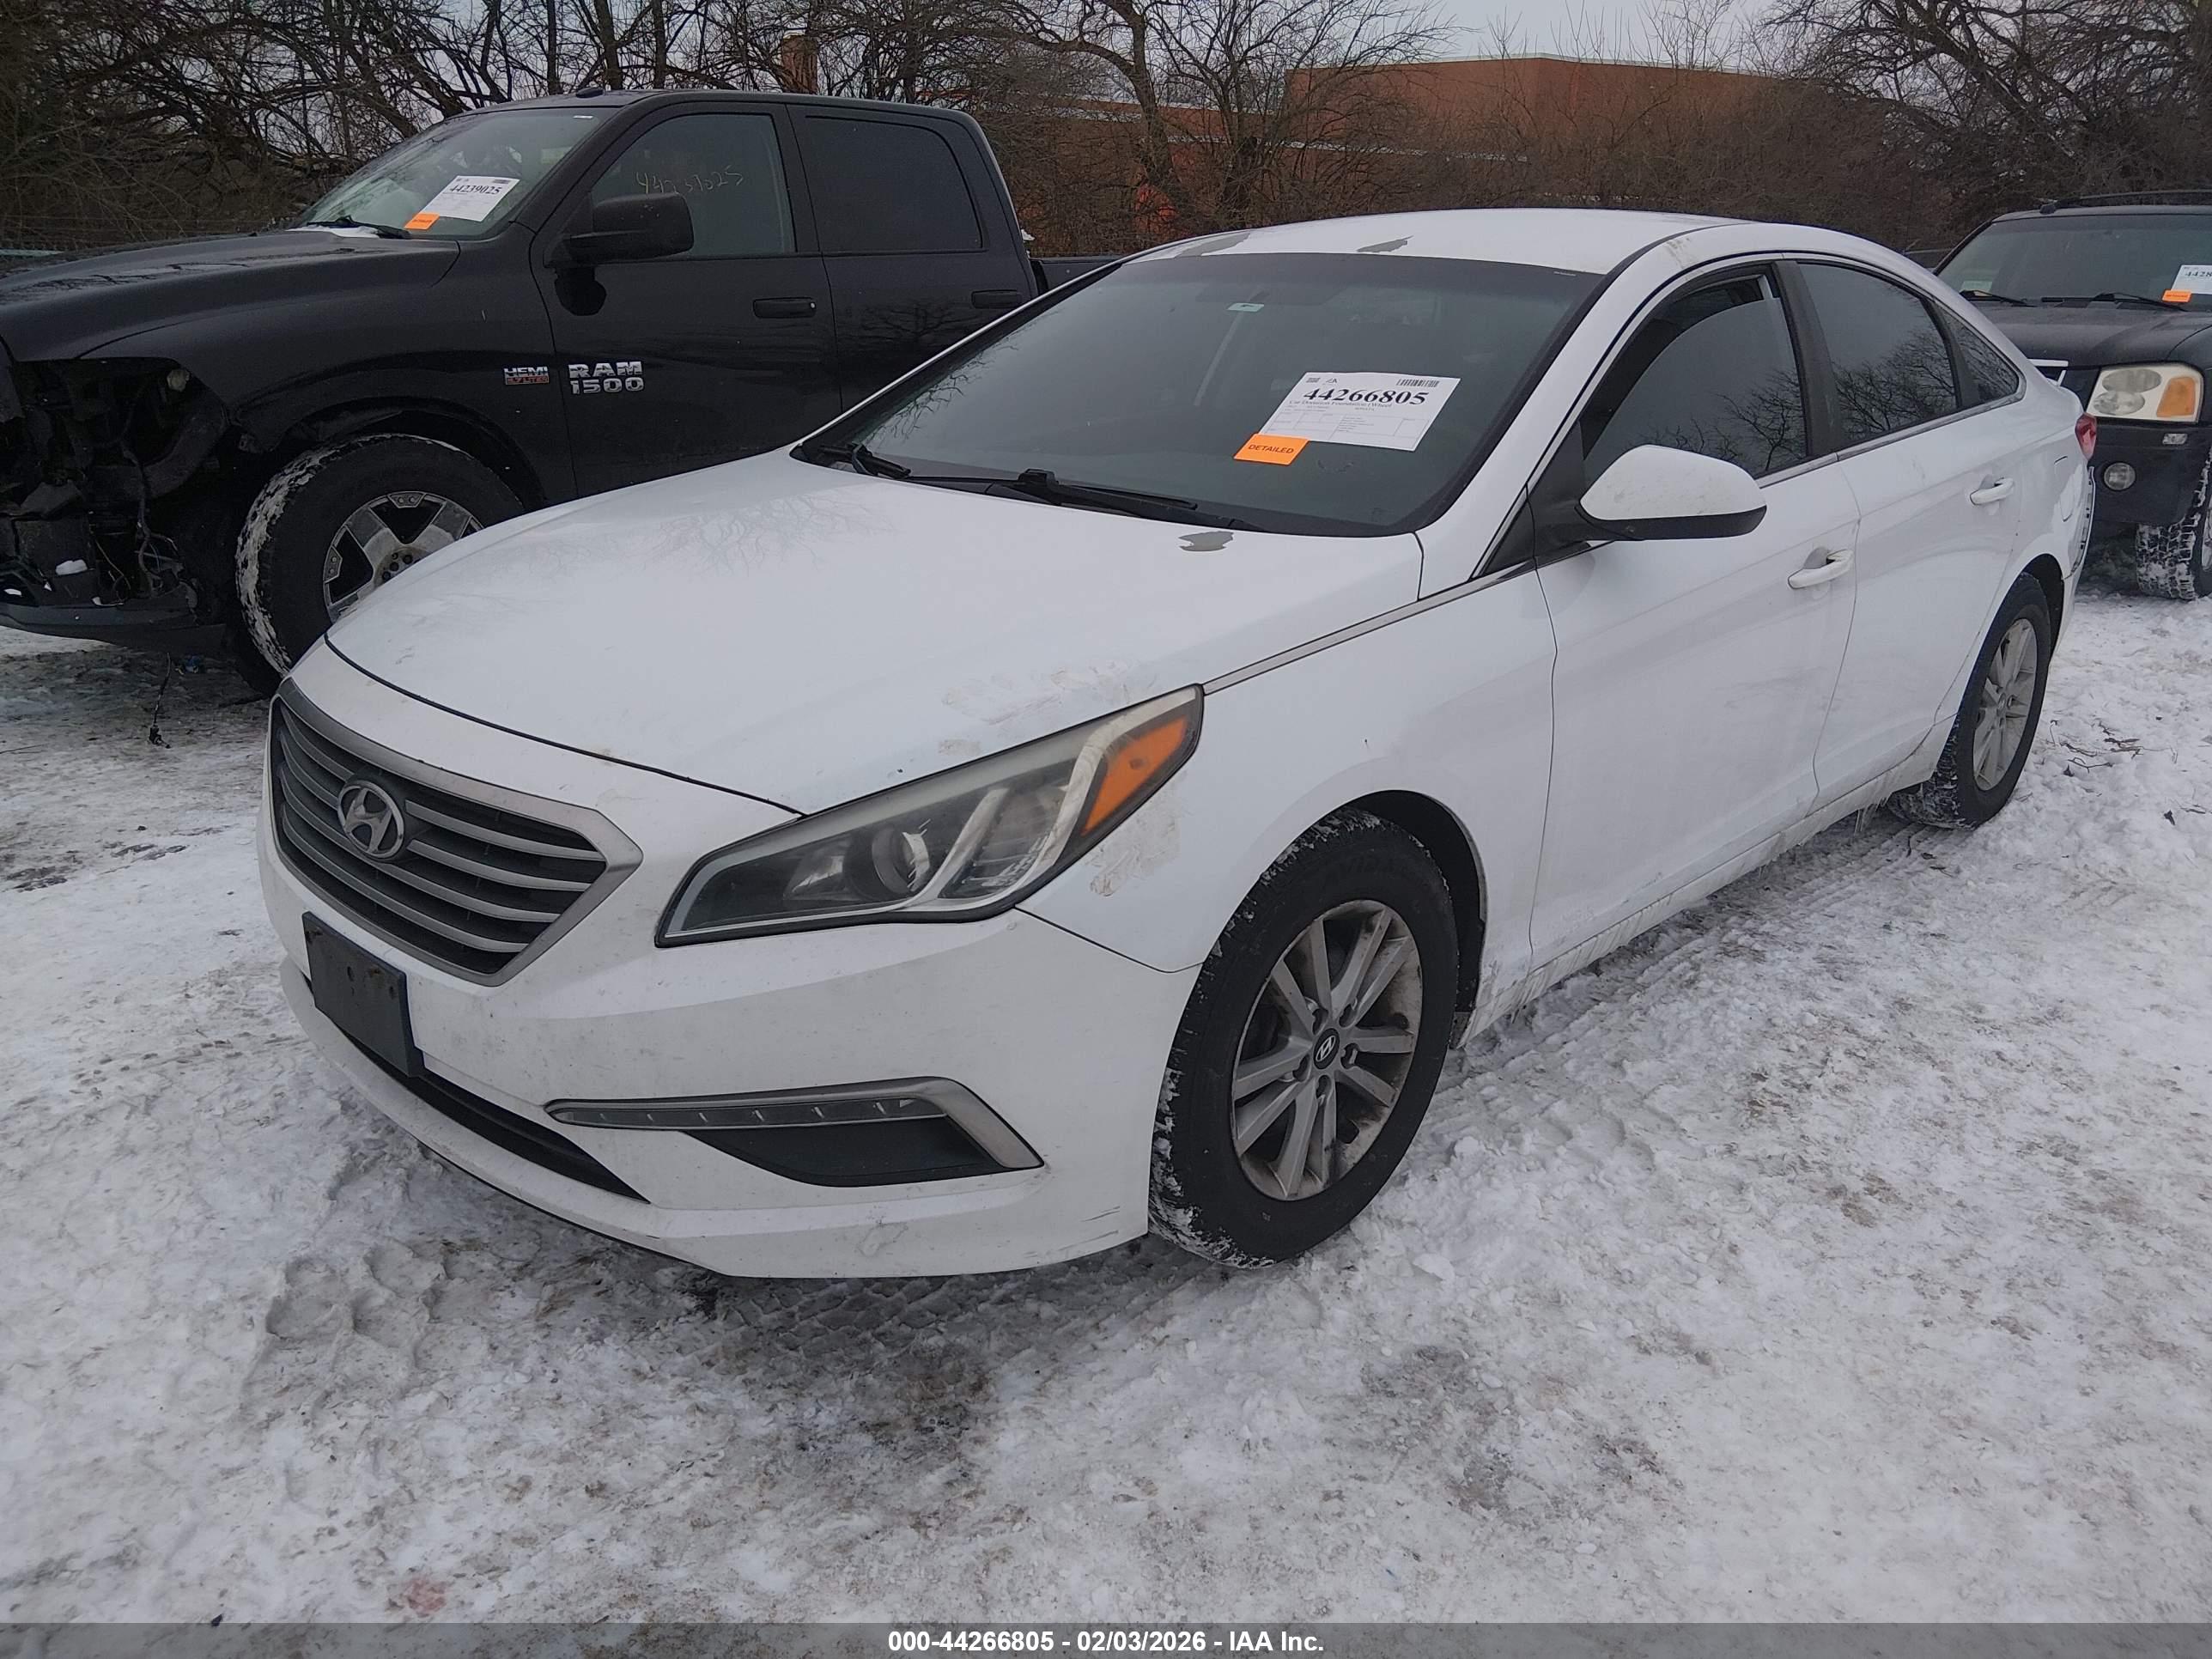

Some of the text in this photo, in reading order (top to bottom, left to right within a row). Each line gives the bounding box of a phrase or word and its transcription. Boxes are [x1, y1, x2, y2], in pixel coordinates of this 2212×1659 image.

[450, 184, 502, 195] 44239025
[503, 366, 549, 377] HEMI
[568, 361, 643, 379] RAM
[569, 377, 645, 394] 1500
[1304, 387, 1430, 405] 44266805
[1248, 444, 1295, 454] DETAILED
